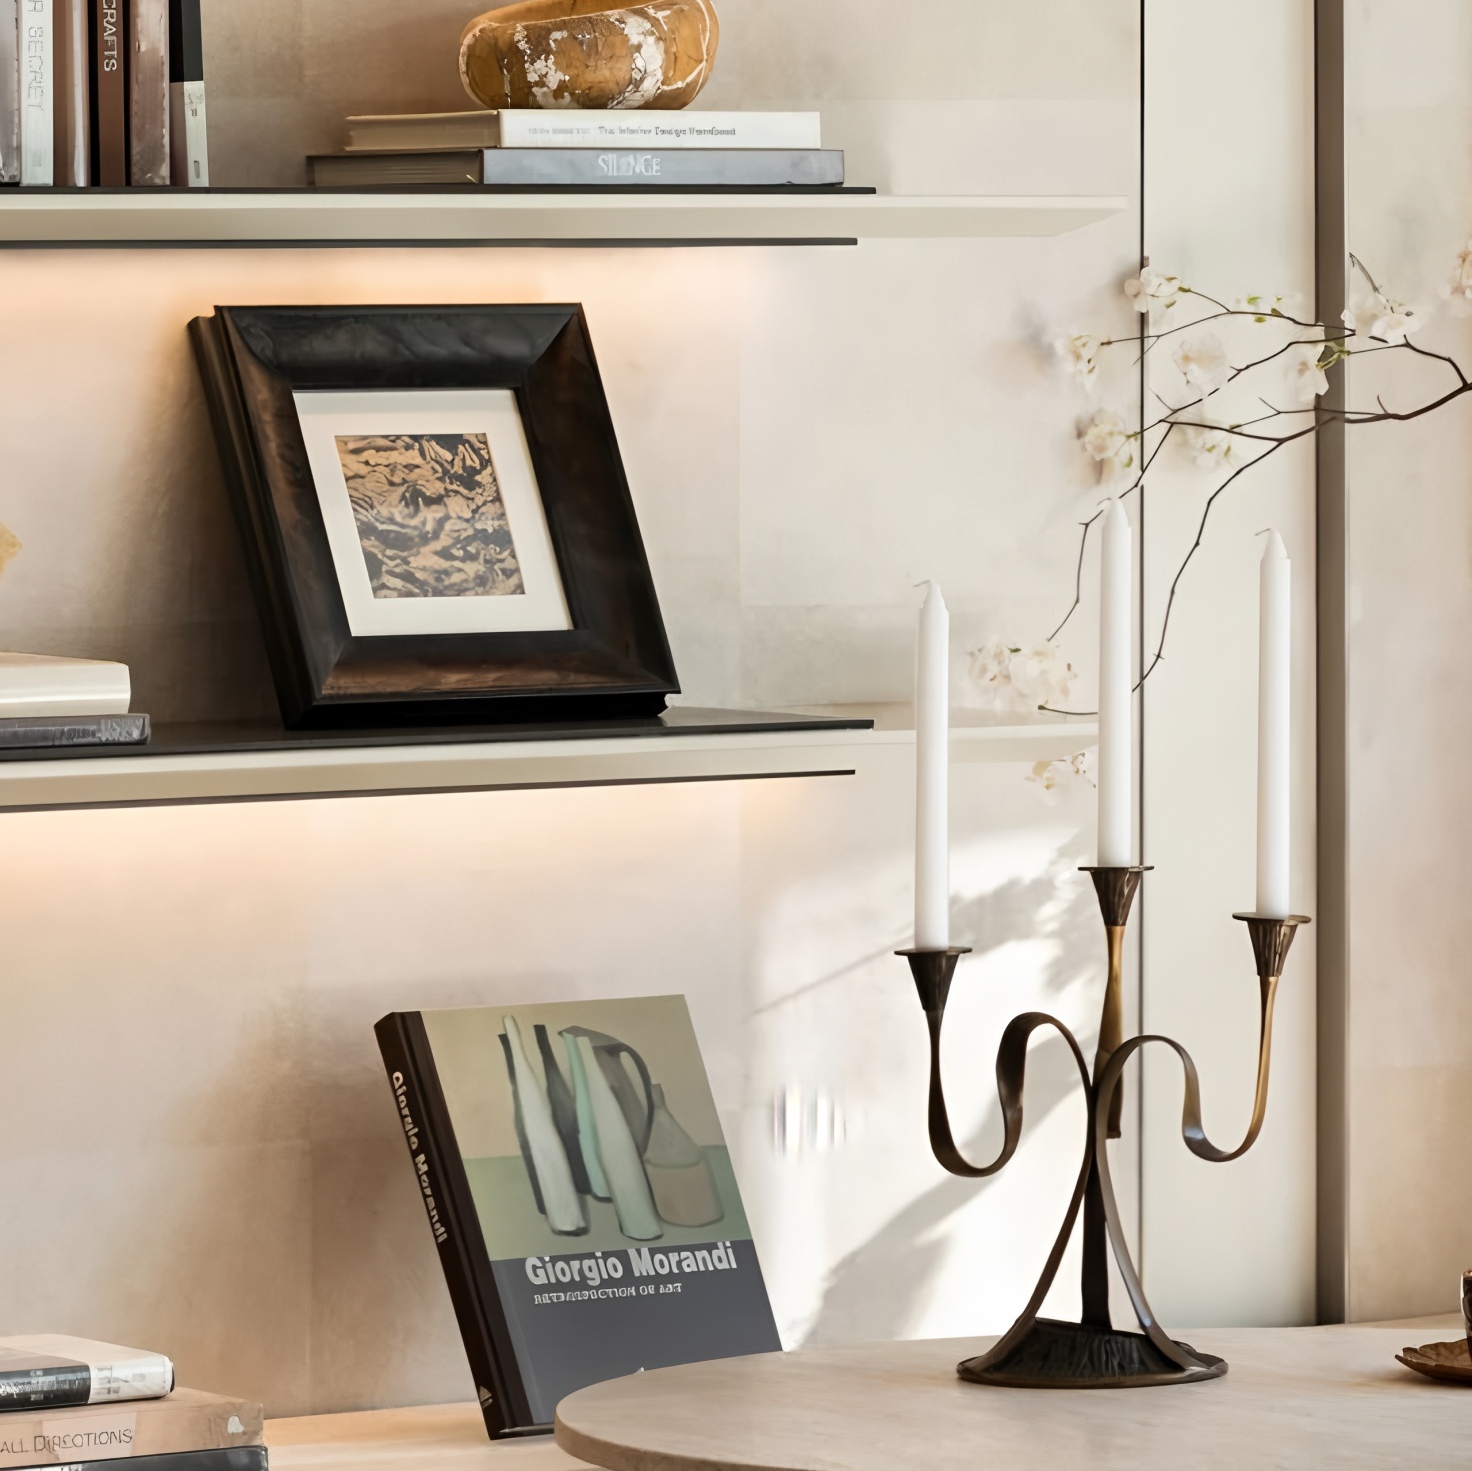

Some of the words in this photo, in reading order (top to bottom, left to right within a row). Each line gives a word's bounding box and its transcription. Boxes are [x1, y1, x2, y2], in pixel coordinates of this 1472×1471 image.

[525, 1251, 624, 1286] Giorgio
[627, 1240, 738, 1277] Morandi
[0, 1437, 29, 1454] ALL
